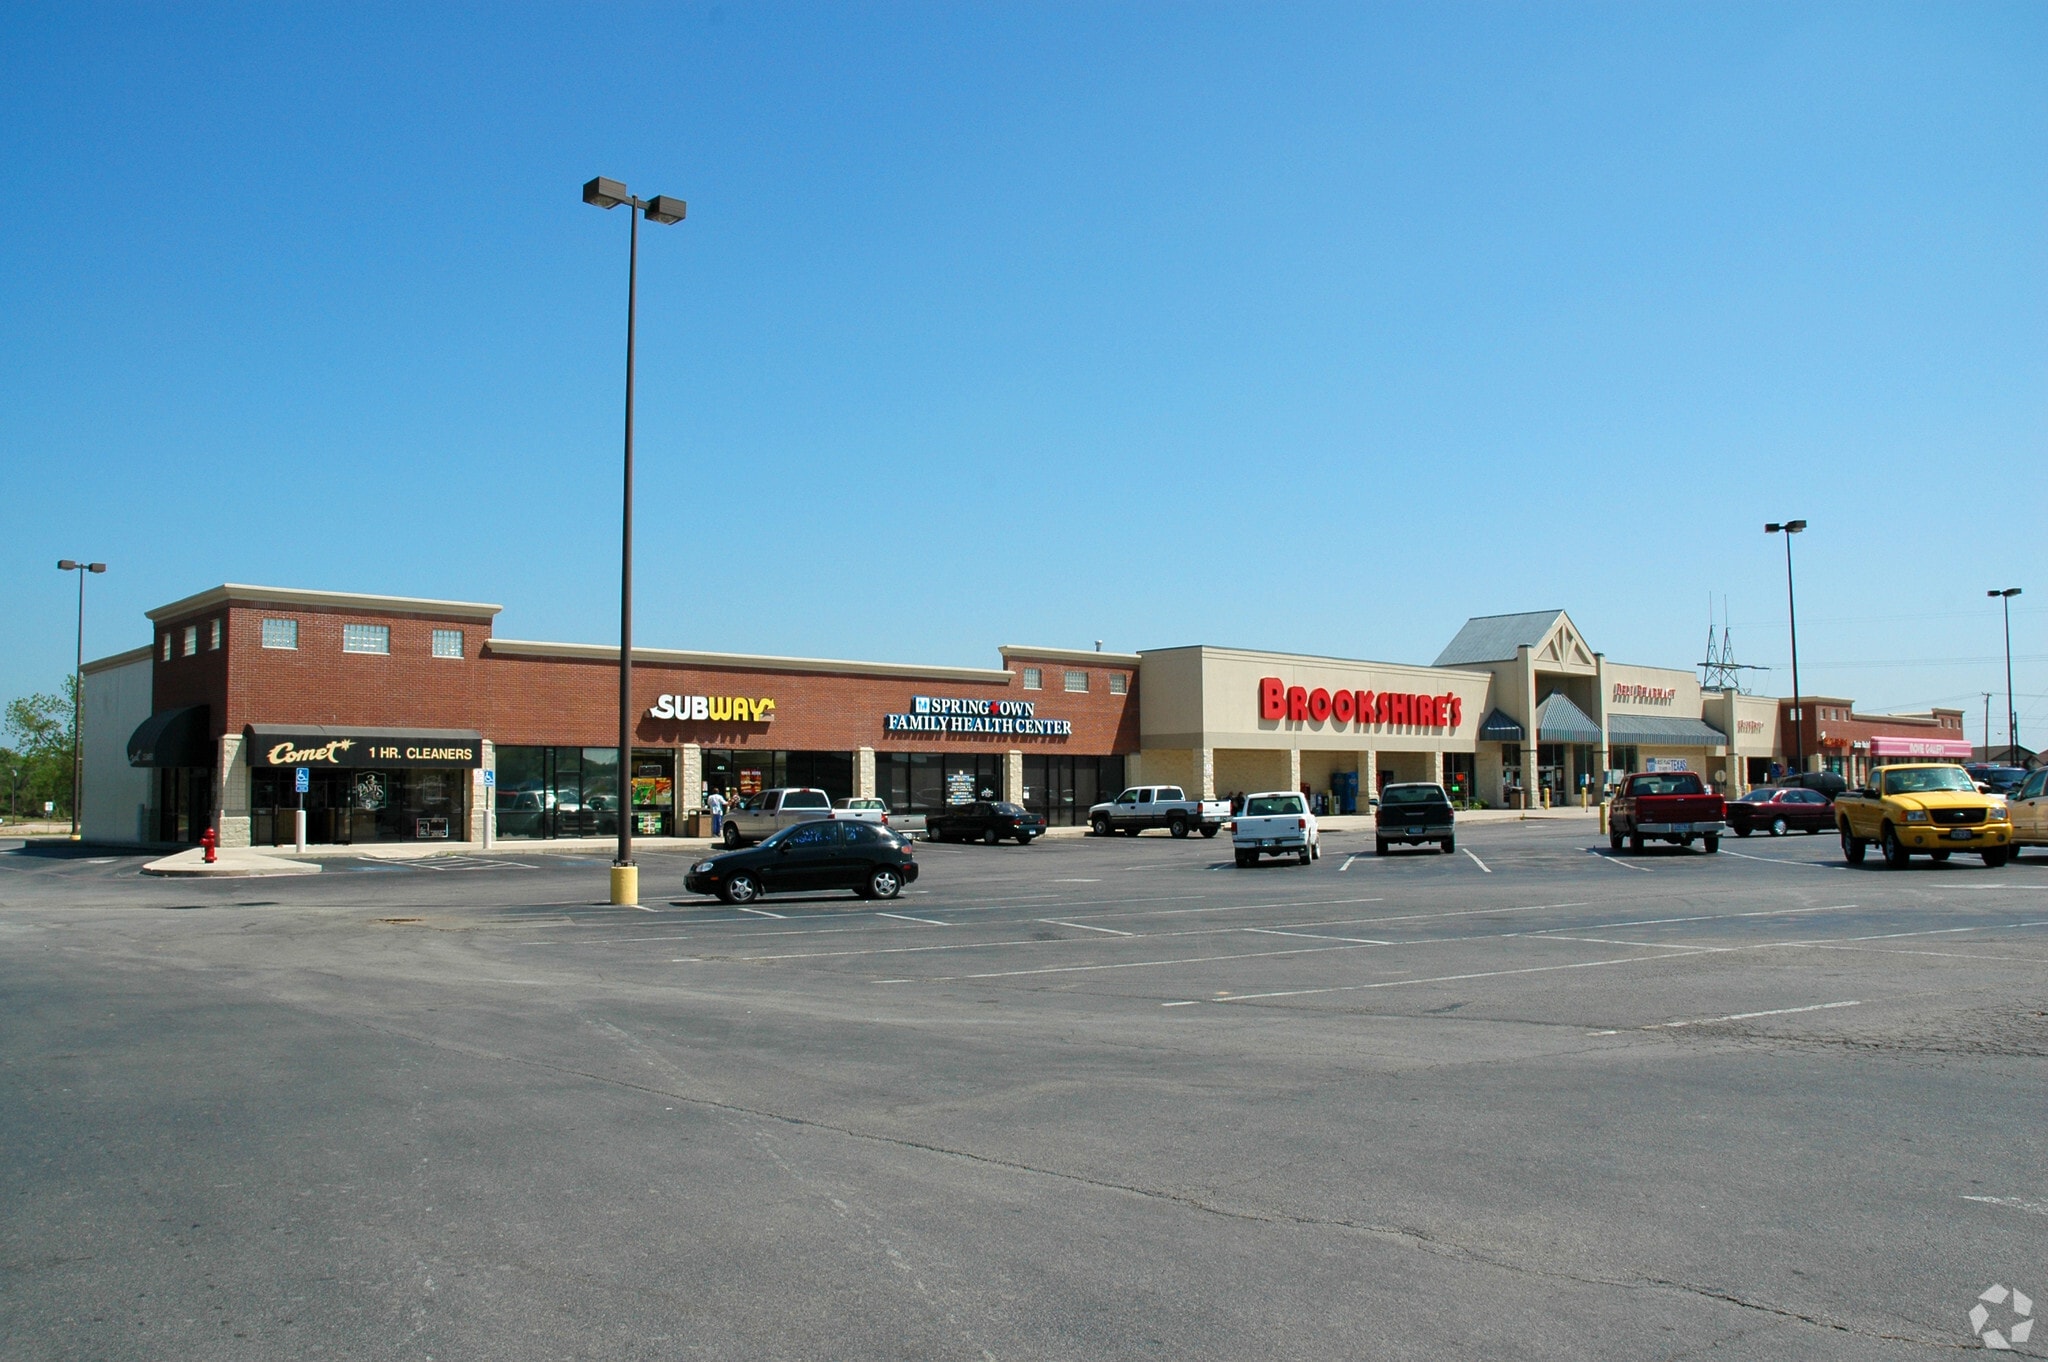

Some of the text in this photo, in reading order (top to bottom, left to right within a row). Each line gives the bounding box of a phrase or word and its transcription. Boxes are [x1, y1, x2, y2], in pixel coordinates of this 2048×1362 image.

[650, 694, 776, 722] SUBWAY
[1259, 676, 1462, 728] BROOKSHIRE'S
[887, 714, 1072, 736] FAMILY HEALTH CENTER
[266, 740, 473, 765] Comet 1 HR. CLEANERS
